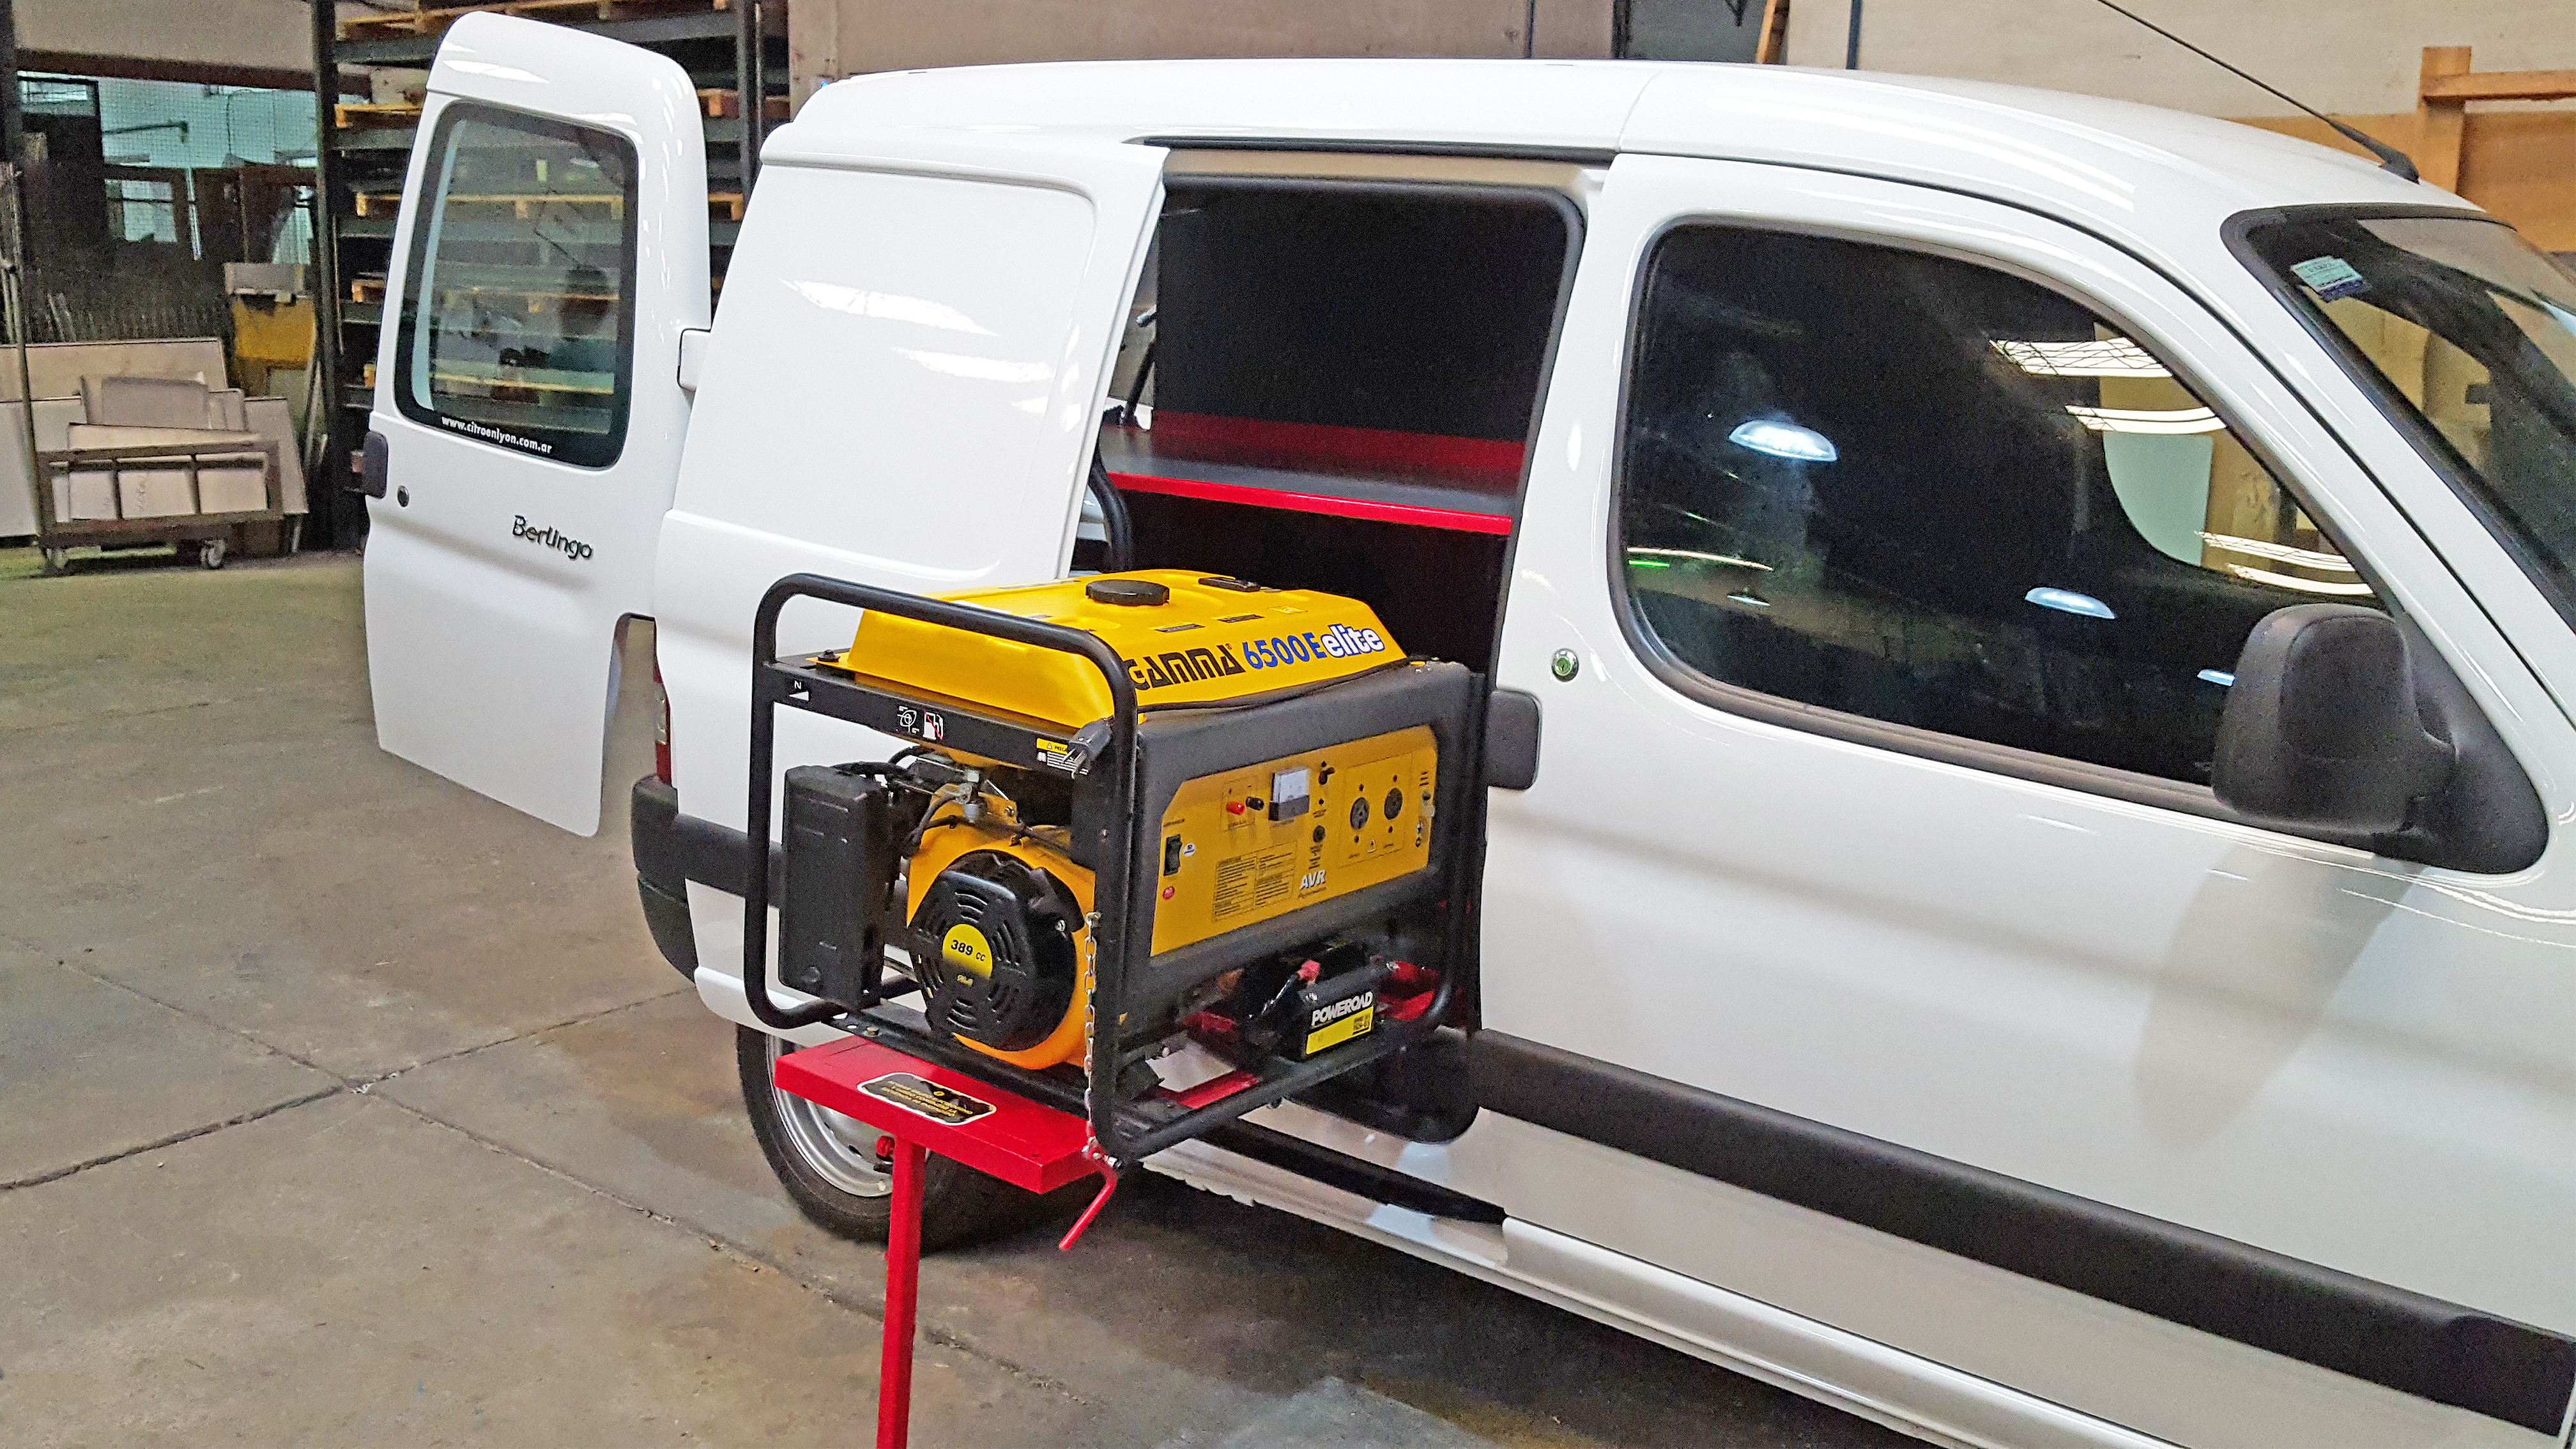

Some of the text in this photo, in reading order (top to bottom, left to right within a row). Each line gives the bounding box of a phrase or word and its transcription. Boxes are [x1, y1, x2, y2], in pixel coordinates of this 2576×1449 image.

[512, 514, 593, 560] Berlingo
[1124, 644, 1246, 691] GAMMA
[1300, 870, 1326, 890] AVR
[950, 939, 974, 956] 389
[1311, 991, 1374, 1027] POWEROAD
